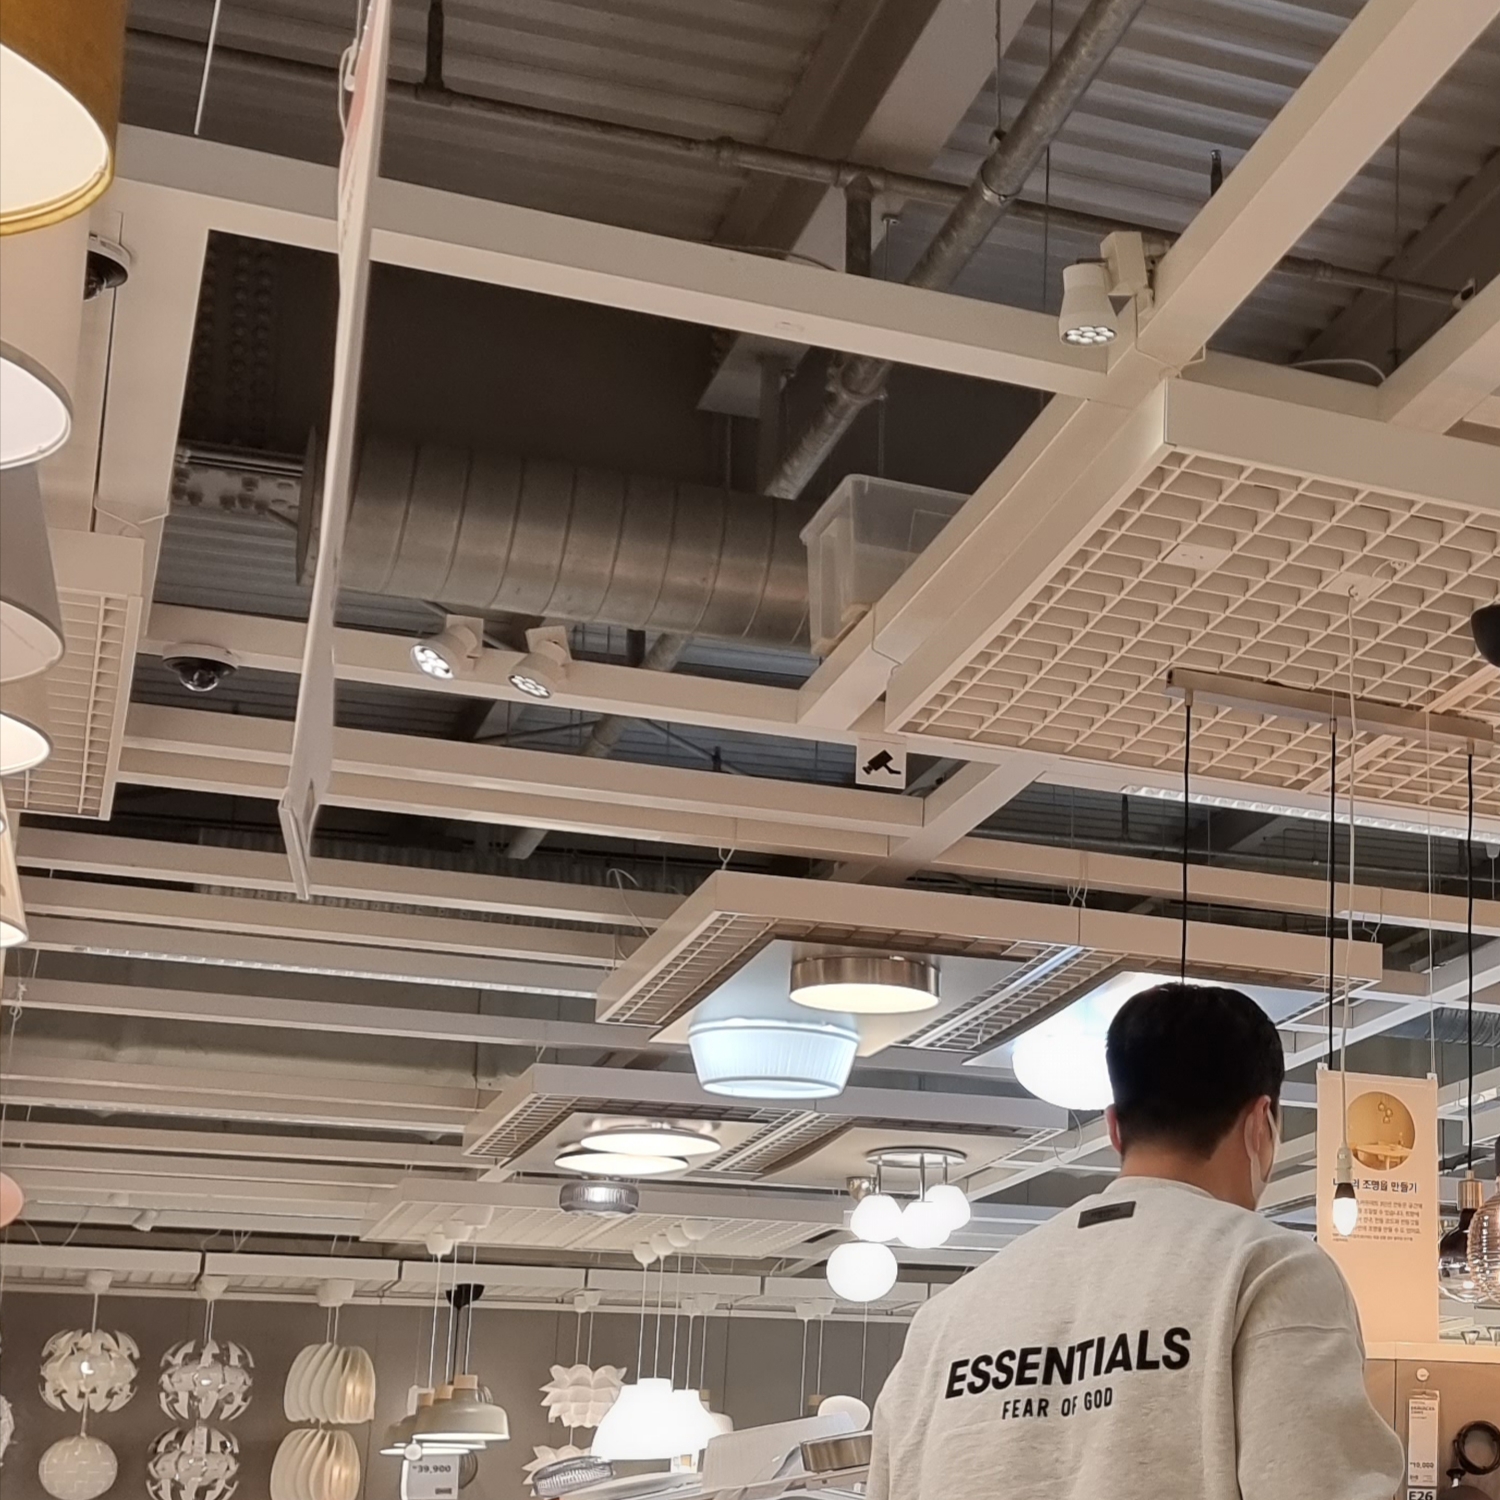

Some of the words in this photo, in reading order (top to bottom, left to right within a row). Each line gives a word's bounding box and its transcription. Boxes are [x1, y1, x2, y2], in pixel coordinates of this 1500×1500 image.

[944, 1327, 1192, 1399] ESSENTIALS
[1002, 1397, 1050, 1420] FEAR
[1060, 1396, 1078, 1417] OF
[1083, 1387, 1114, 1410] GOD
